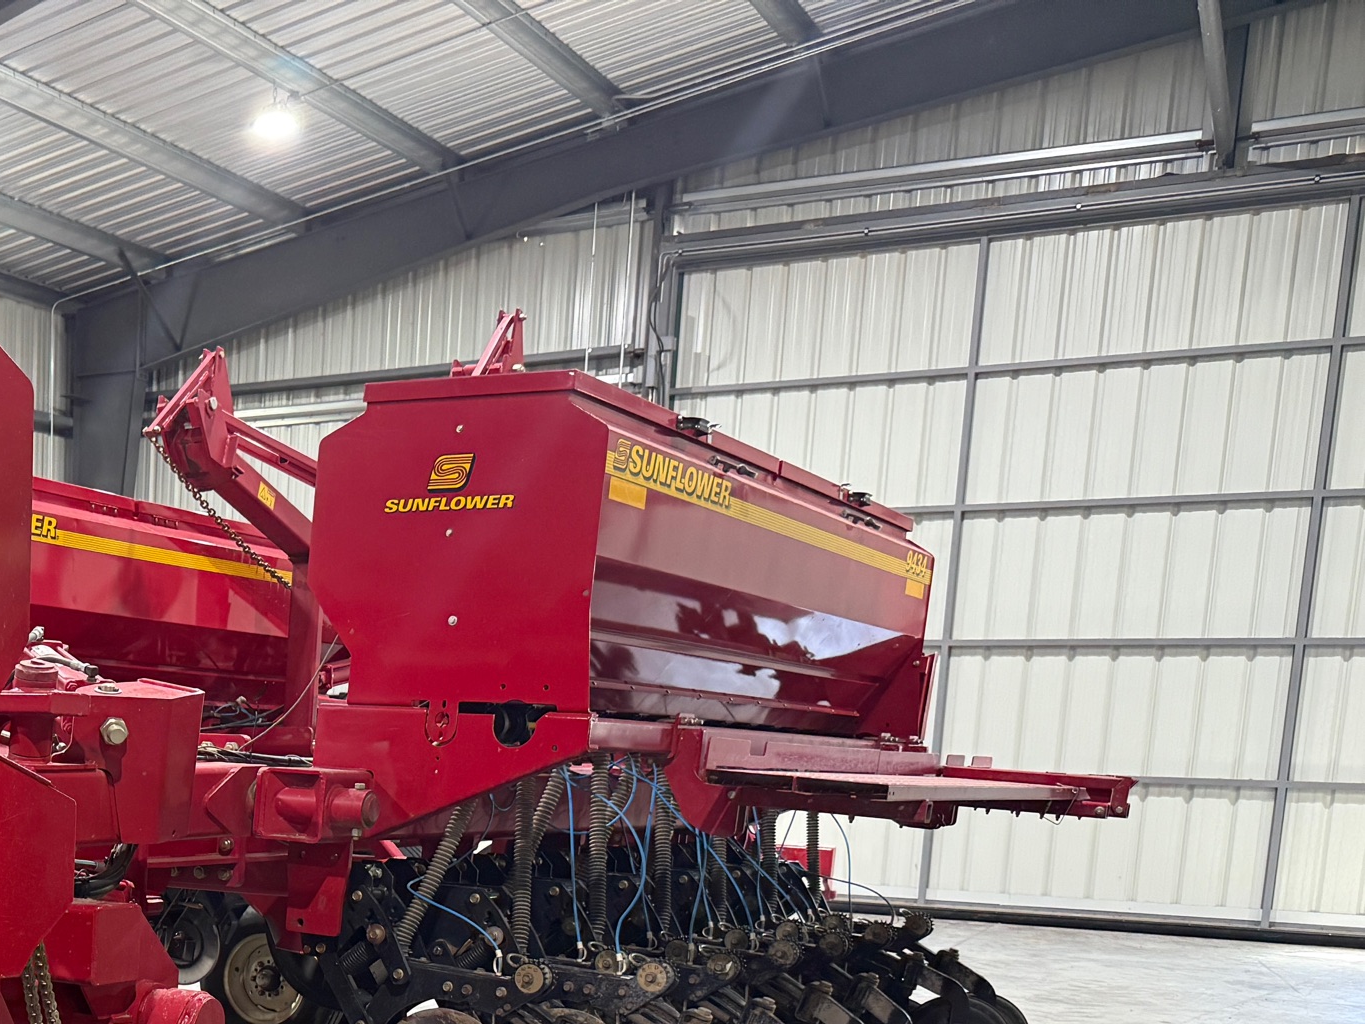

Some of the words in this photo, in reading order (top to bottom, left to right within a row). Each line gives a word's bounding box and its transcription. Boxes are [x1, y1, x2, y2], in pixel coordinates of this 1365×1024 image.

[628, 445, 733, 509] SUNFLOWER
[384, 494, 516, 513] SUNFLOWER
[905, 550, 928, 578] 9434
